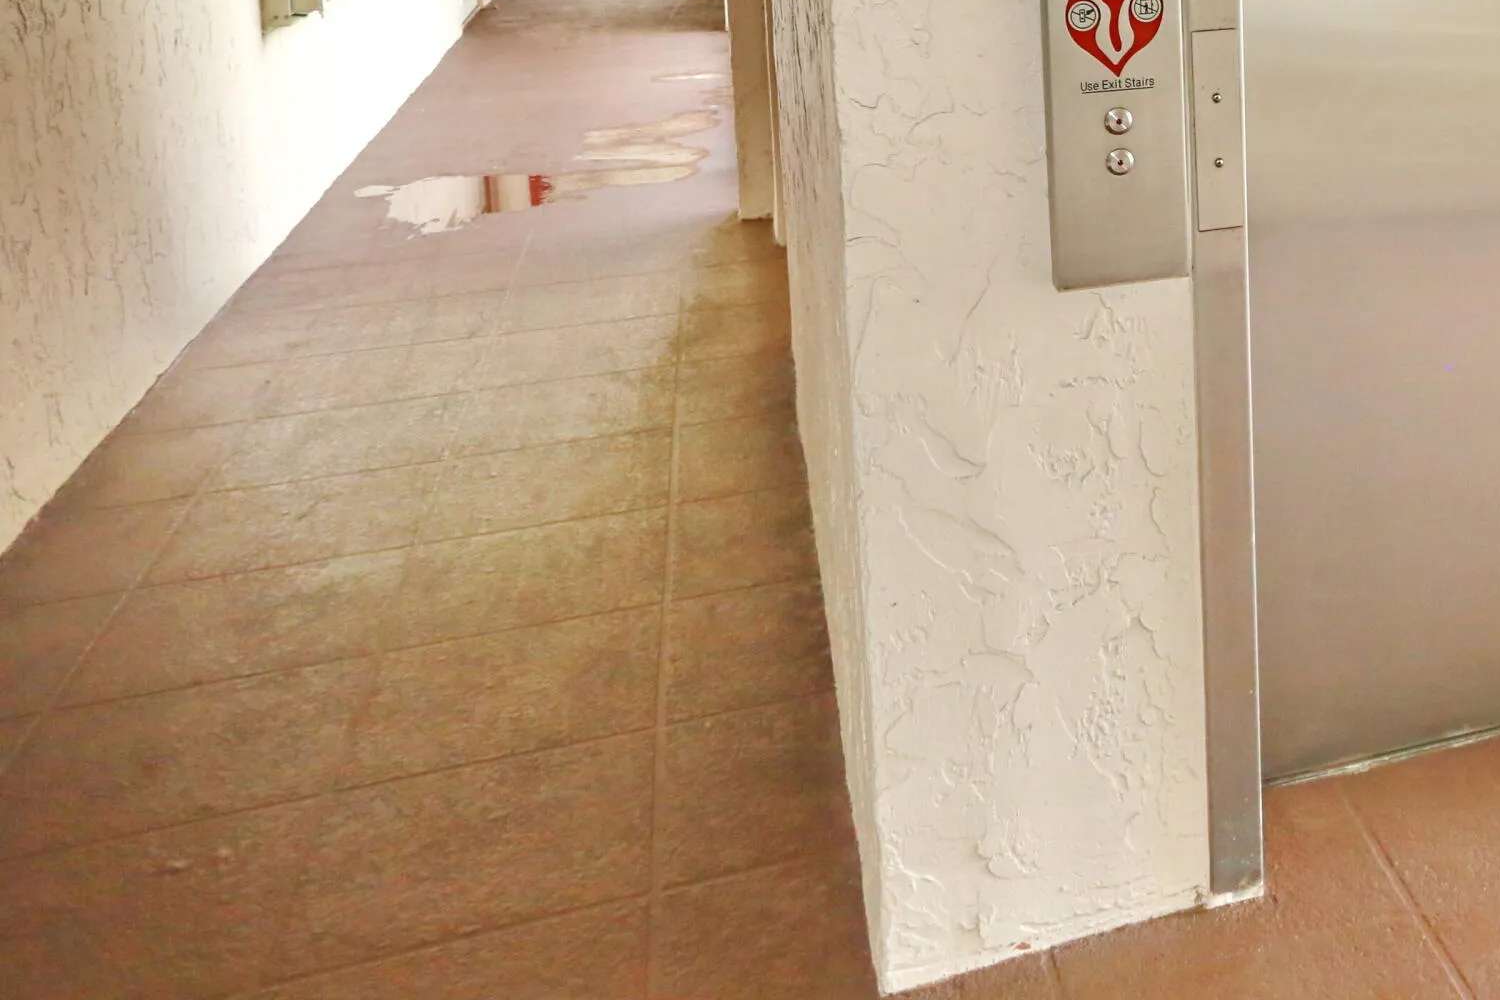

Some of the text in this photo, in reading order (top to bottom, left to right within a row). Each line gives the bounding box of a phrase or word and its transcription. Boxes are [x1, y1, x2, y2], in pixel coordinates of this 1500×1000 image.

[1080, 77, 1155, 92] Use Exit Stairs
